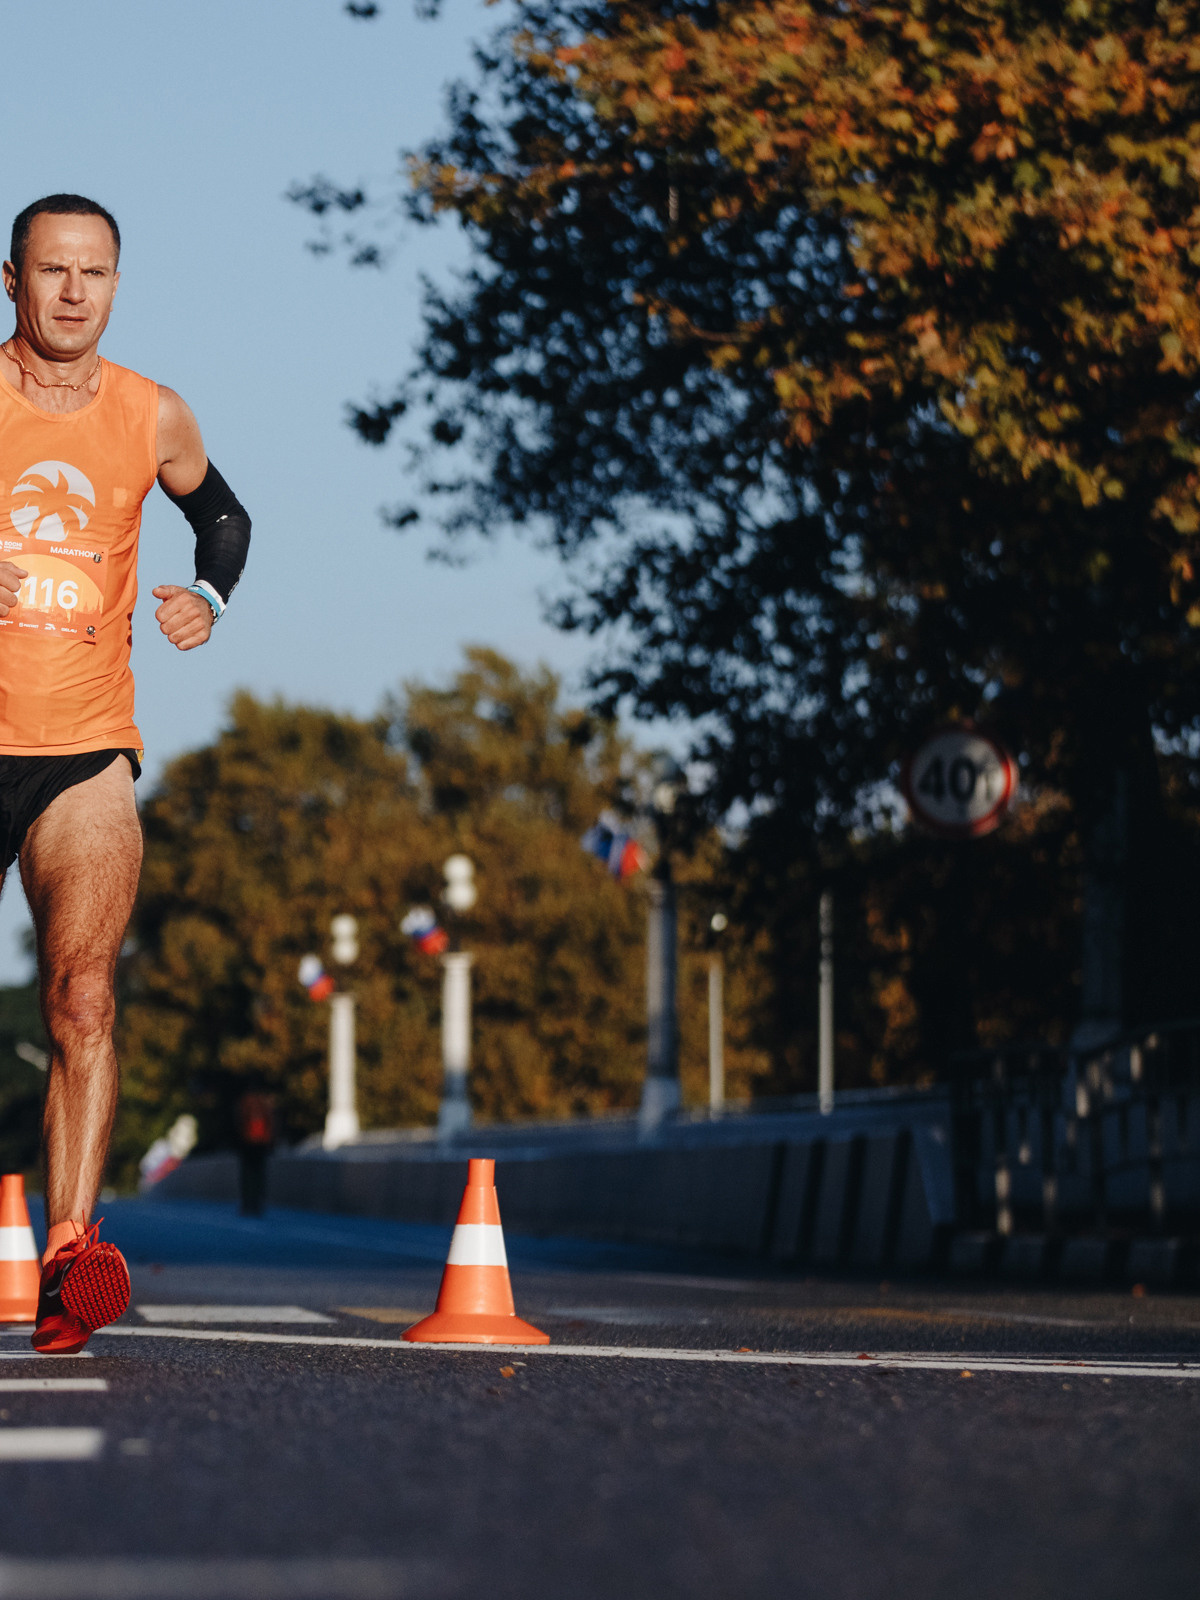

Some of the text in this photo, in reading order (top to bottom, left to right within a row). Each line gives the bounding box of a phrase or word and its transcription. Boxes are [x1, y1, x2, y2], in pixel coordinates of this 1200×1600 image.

[50, 546, 97, 559] MARATHON
[14, 576, 79, 610] 116
[918, 757, 976, 800] 40
